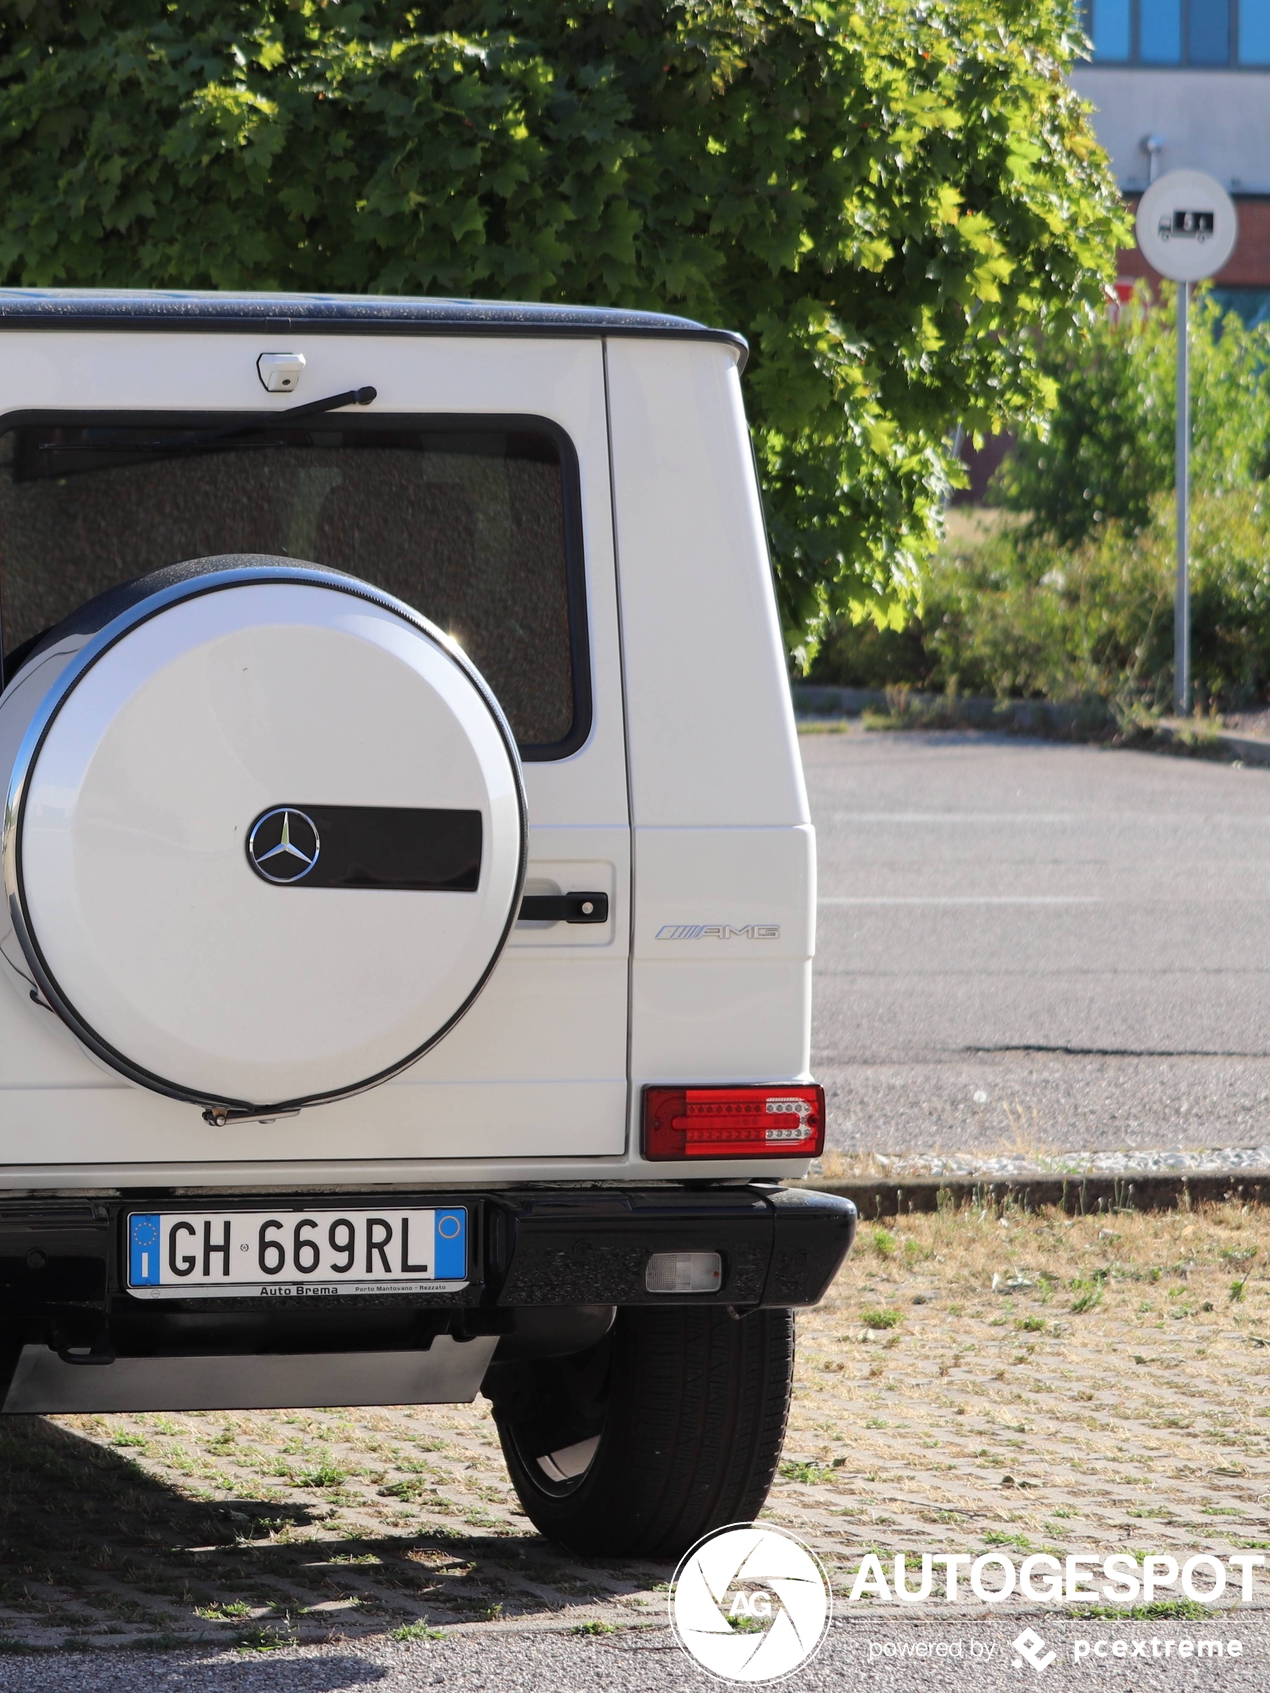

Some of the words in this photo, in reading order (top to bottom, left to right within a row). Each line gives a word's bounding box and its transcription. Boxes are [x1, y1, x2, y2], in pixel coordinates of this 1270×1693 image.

[694, 924, 781, 940] AMG
[168, 1220, 231, 1277] GH
[258, 1217, 428, 1275] 669RL
[260, 1286, 292, 1296] Auto
[296, 1285, 339, 1296] Brema
[376, 1284, 413, 1292] Mantovano
